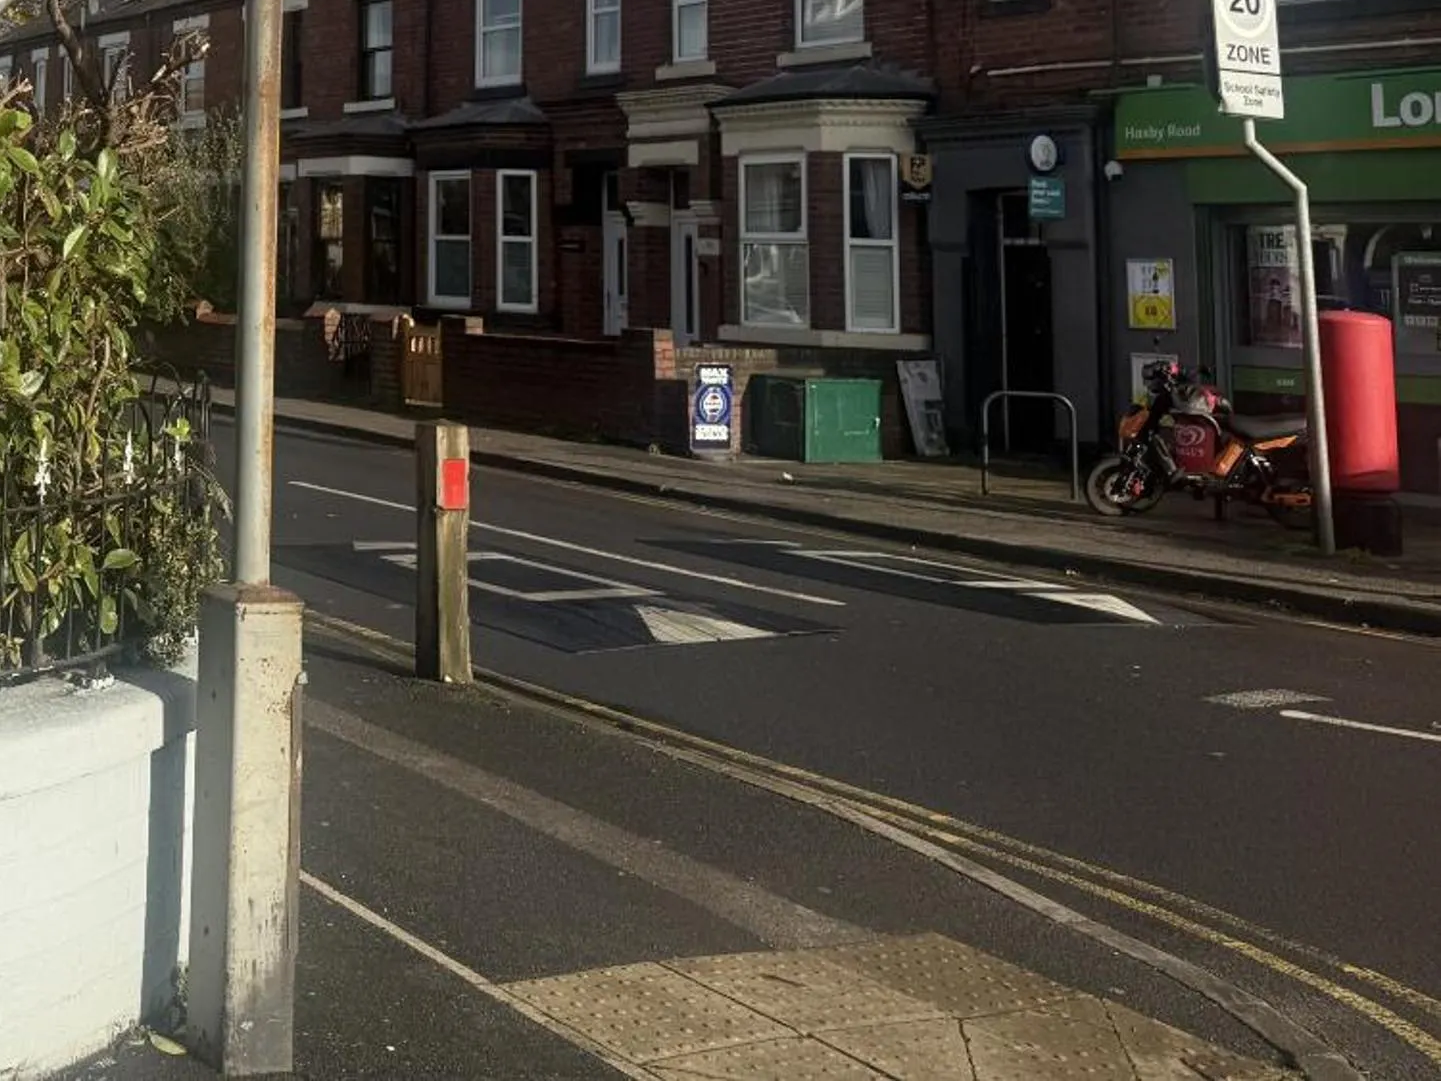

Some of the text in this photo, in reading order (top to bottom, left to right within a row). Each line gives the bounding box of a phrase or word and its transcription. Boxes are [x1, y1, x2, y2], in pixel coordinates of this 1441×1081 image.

[1227, 43, 1271, 65] ZONE
[1371, 83, 1441, 127] Lo
[1167, 122, 1201, 137] Road
